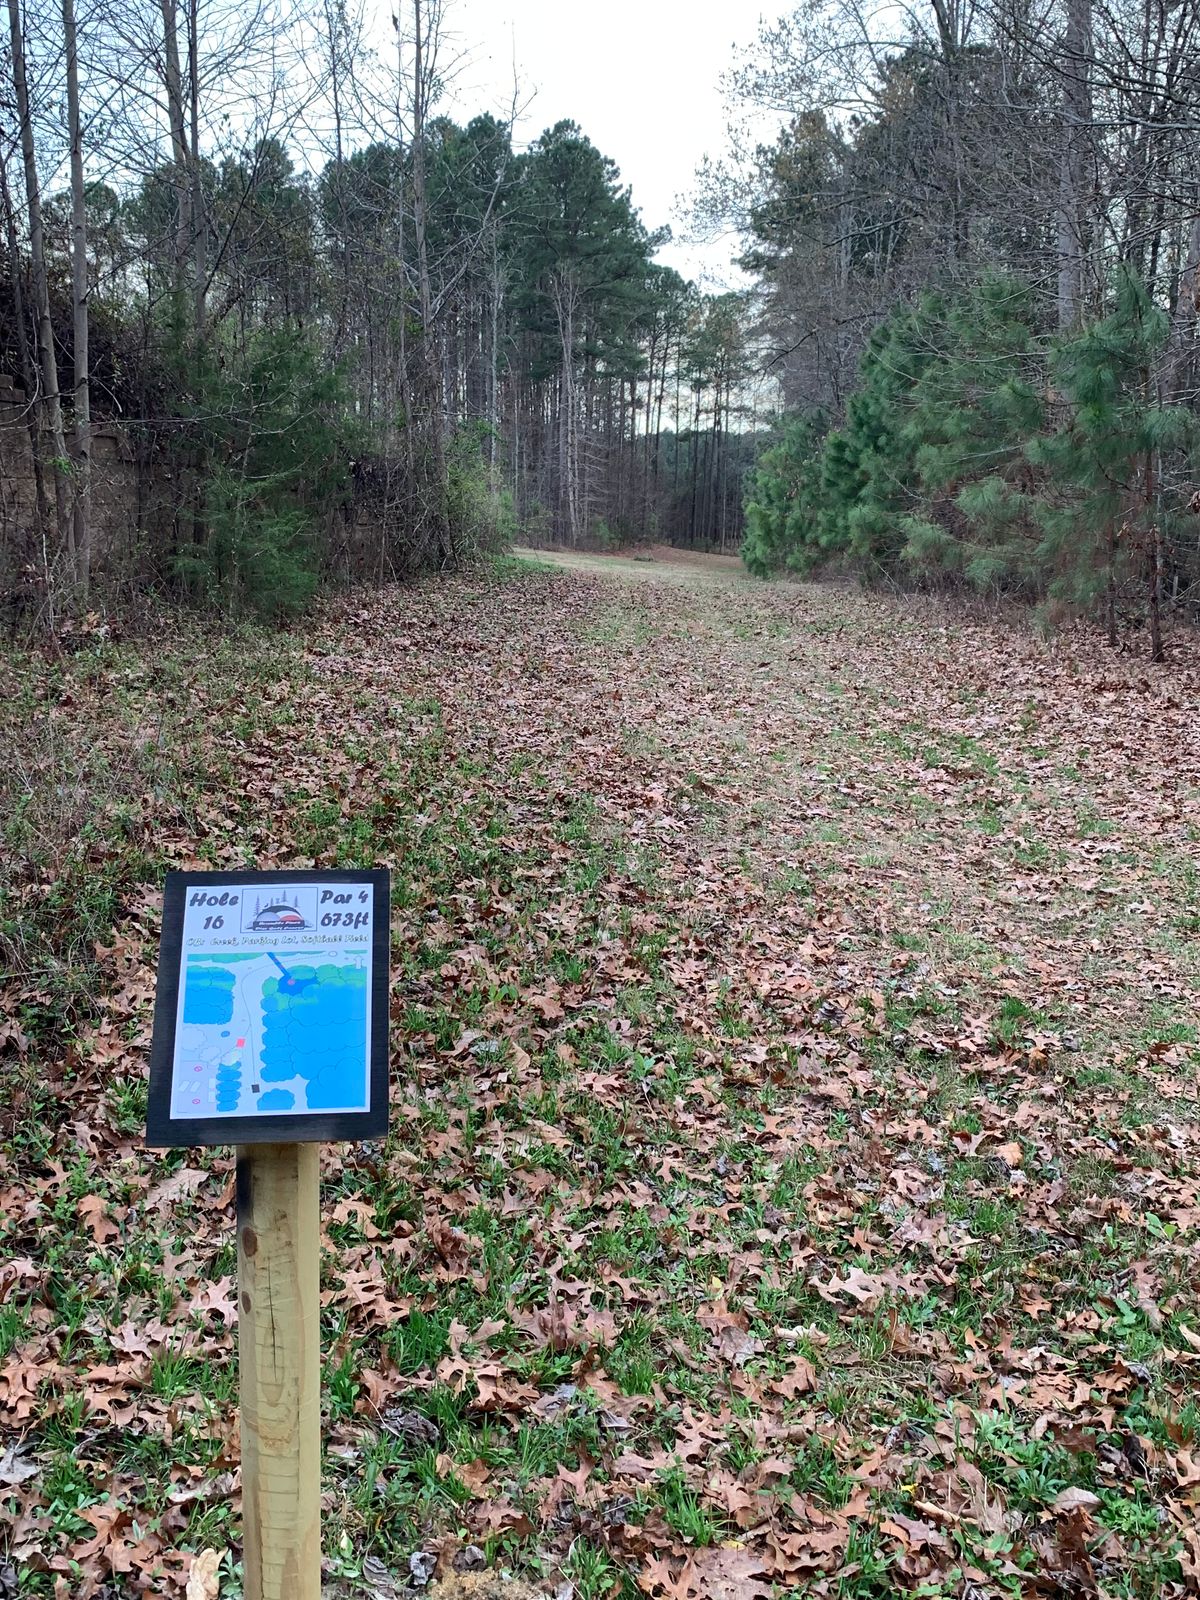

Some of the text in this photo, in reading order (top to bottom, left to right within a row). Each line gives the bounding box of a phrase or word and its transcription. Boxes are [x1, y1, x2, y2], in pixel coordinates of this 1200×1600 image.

[189, 892, 240, 907] Hole
[320, 889, 369, 905] Par 4
[203, 915, 225, 930] 16
[320, 912, 369, 930] 673ft
